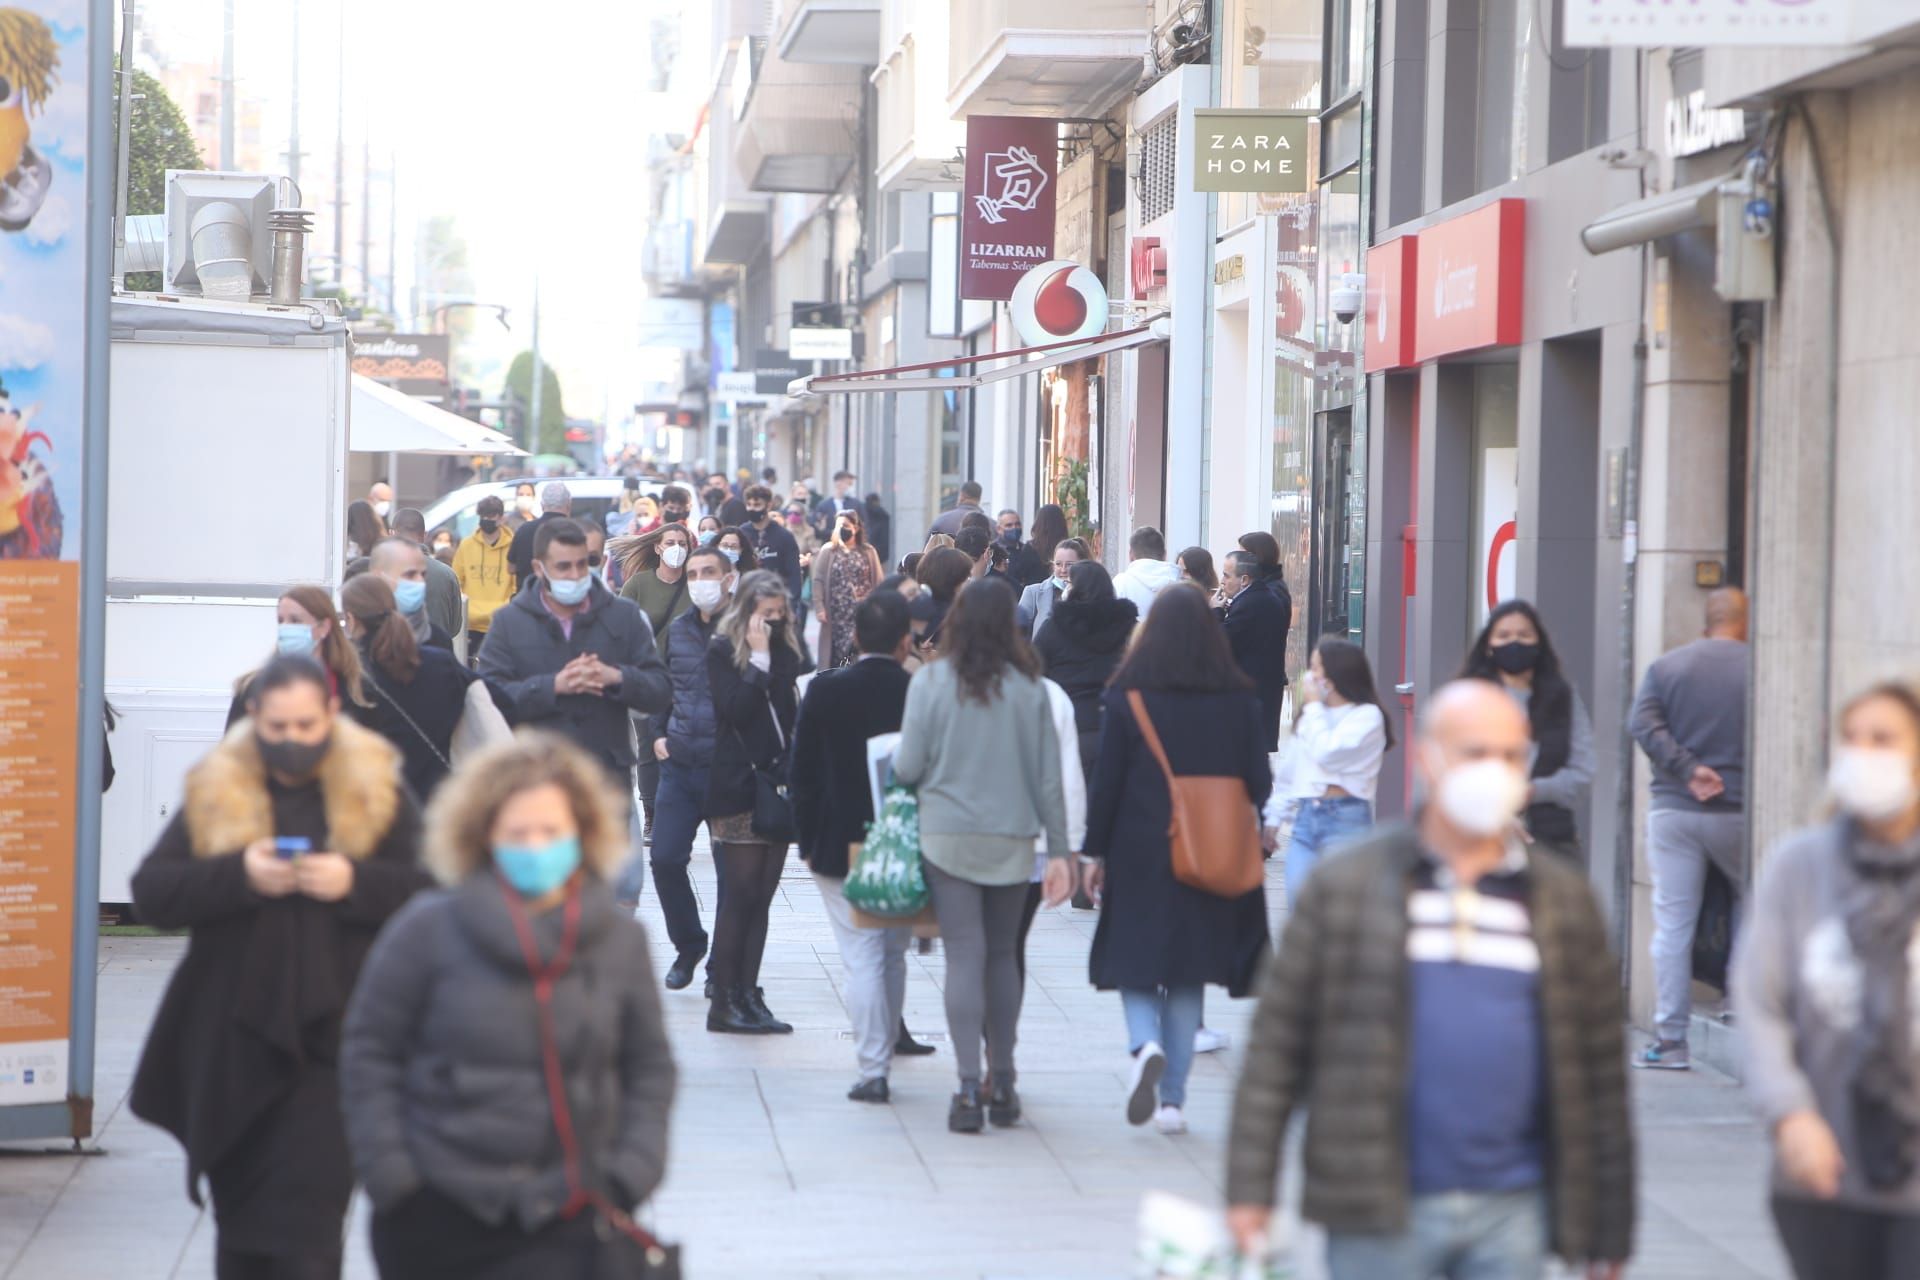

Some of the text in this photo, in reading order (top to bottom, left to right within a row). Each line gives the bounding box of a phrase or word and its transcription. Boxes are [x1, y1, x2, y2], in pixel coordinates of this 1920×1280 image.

[1210, 134, 1291, 150] ZARA
[1207, 158, 1293, 174] HOME
[970, 243, 1048, 258] LIZARRAN
[970, 258, 1009, 270] Tabernas
